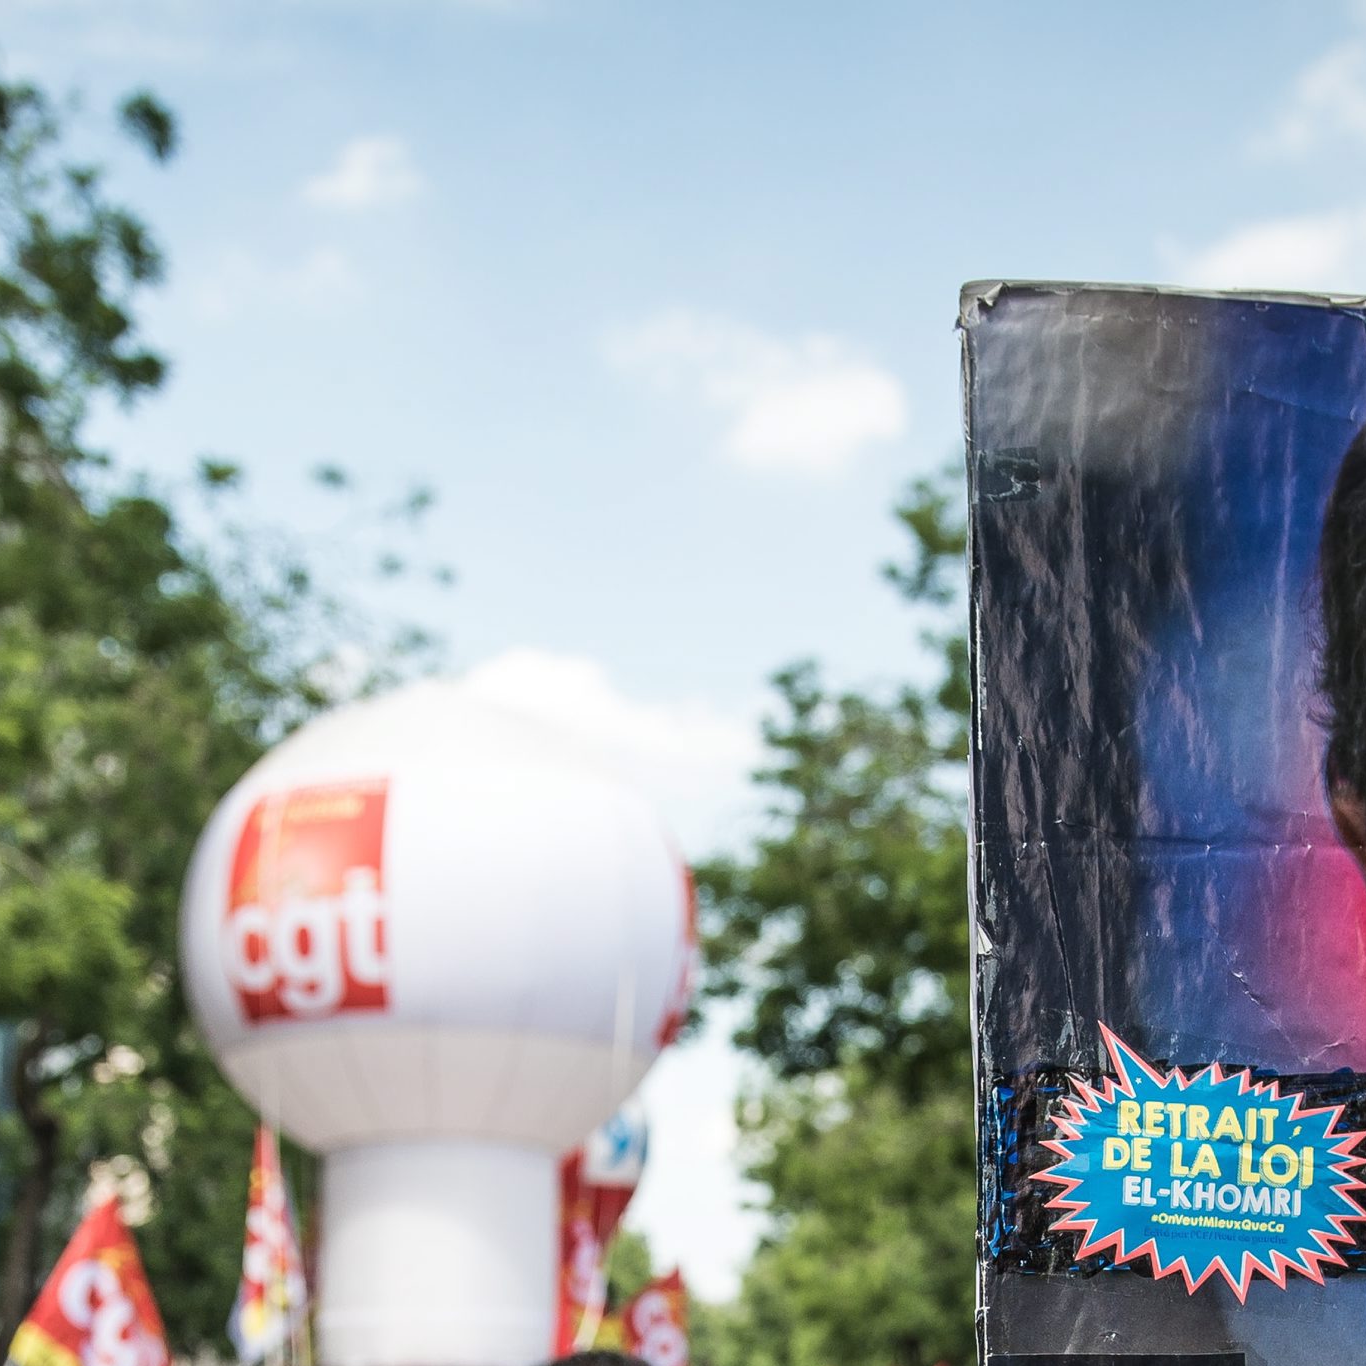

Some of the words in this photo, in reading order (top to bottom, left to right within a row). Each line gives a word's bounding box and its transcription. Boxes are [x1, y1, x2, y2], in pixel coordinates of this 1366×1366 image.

[229, 866, 387, 1007] cgt
[1117, 1100, 1280, 1145] RETRAIT
[1102, 1137, 1152, 1171] DE
[1169, 1141, 1221, 1179] LA
[1237, 1142, 1315, 1190] LOI
[1122, 1175, 1302, 1217] EL-KHOMRI
